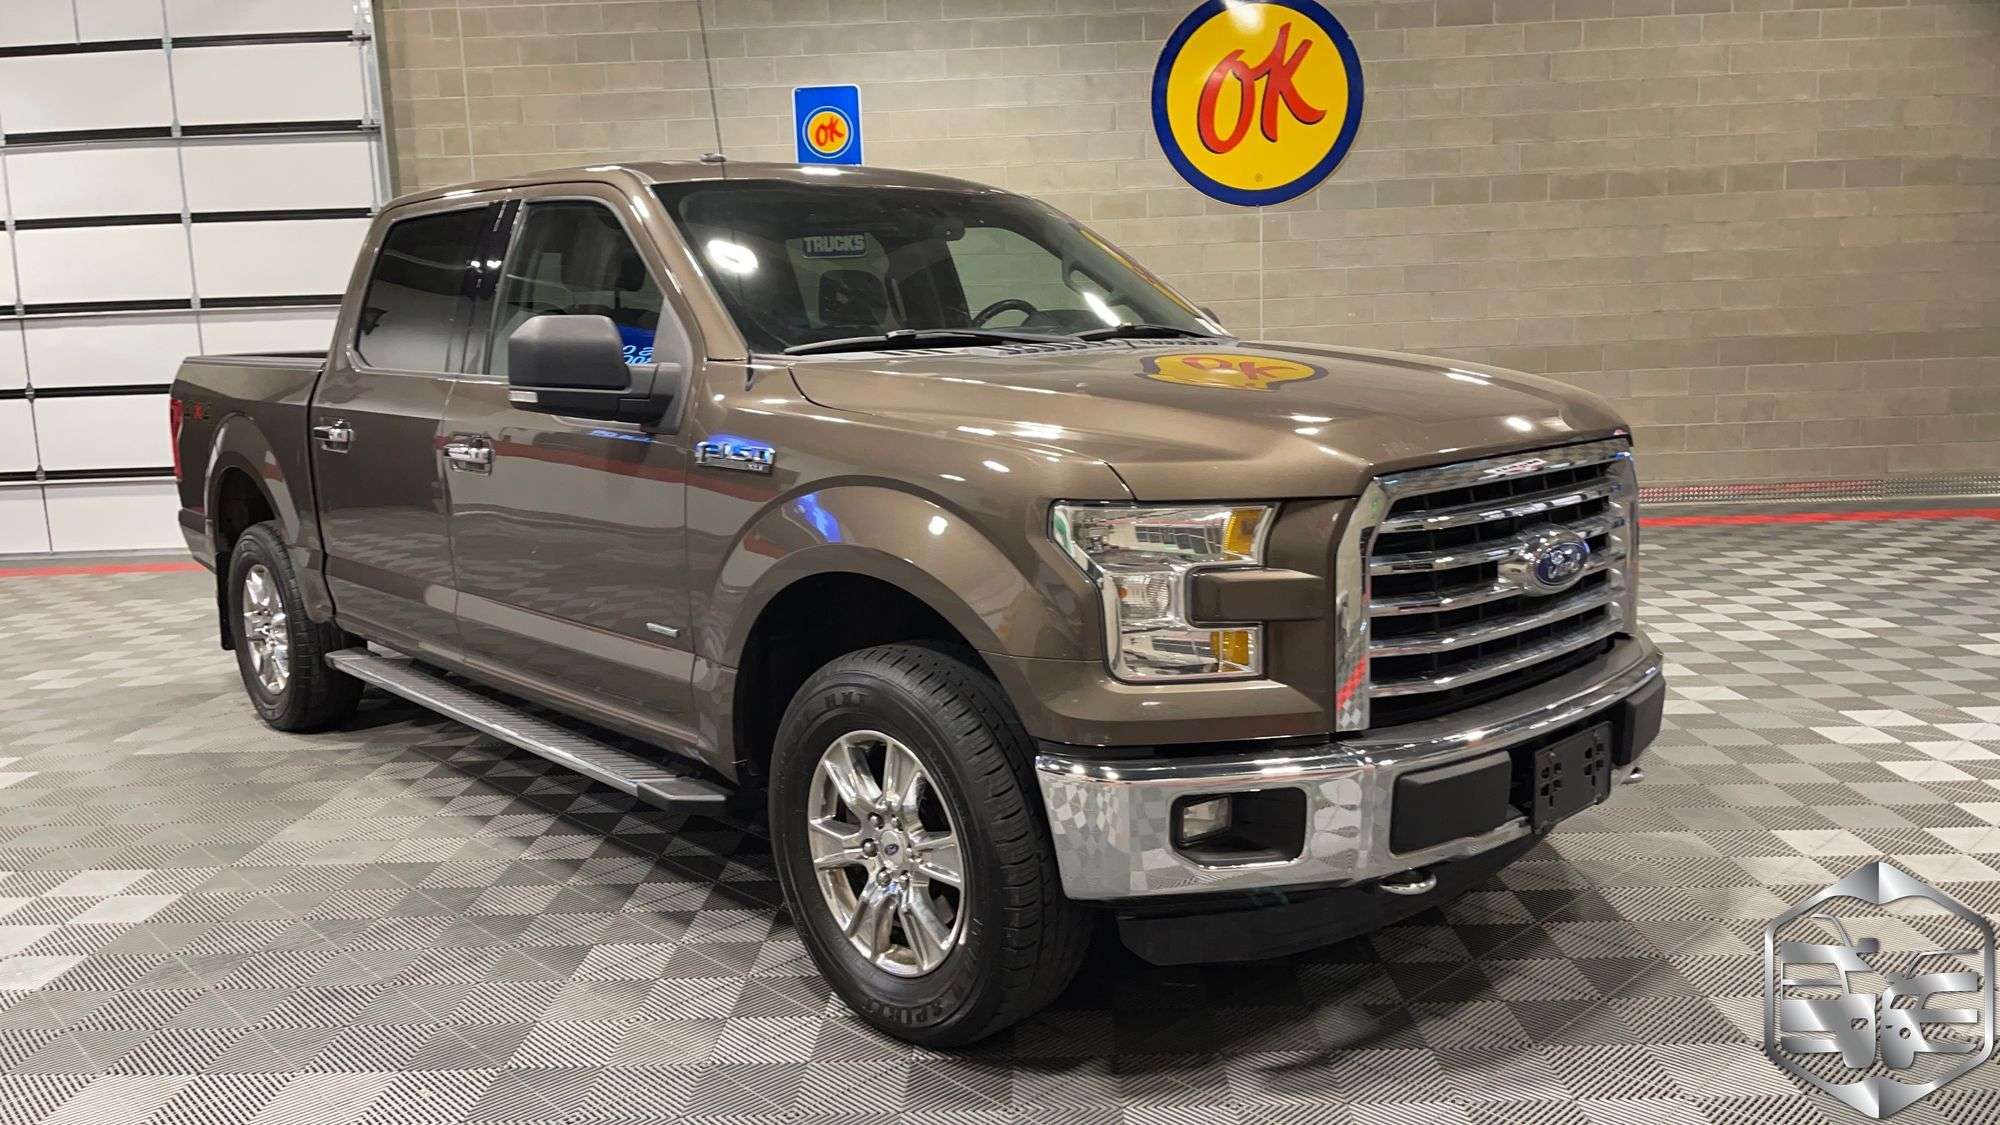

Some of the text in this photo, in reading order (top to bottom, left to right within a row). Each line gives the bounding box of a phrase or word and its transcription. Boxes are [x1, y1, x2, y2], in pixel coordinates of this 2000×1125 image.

[1197, 22, 1328, 155] OK
[815, 116, 845, 147] OK
[803, 235, 865, 253] TRUCKS
